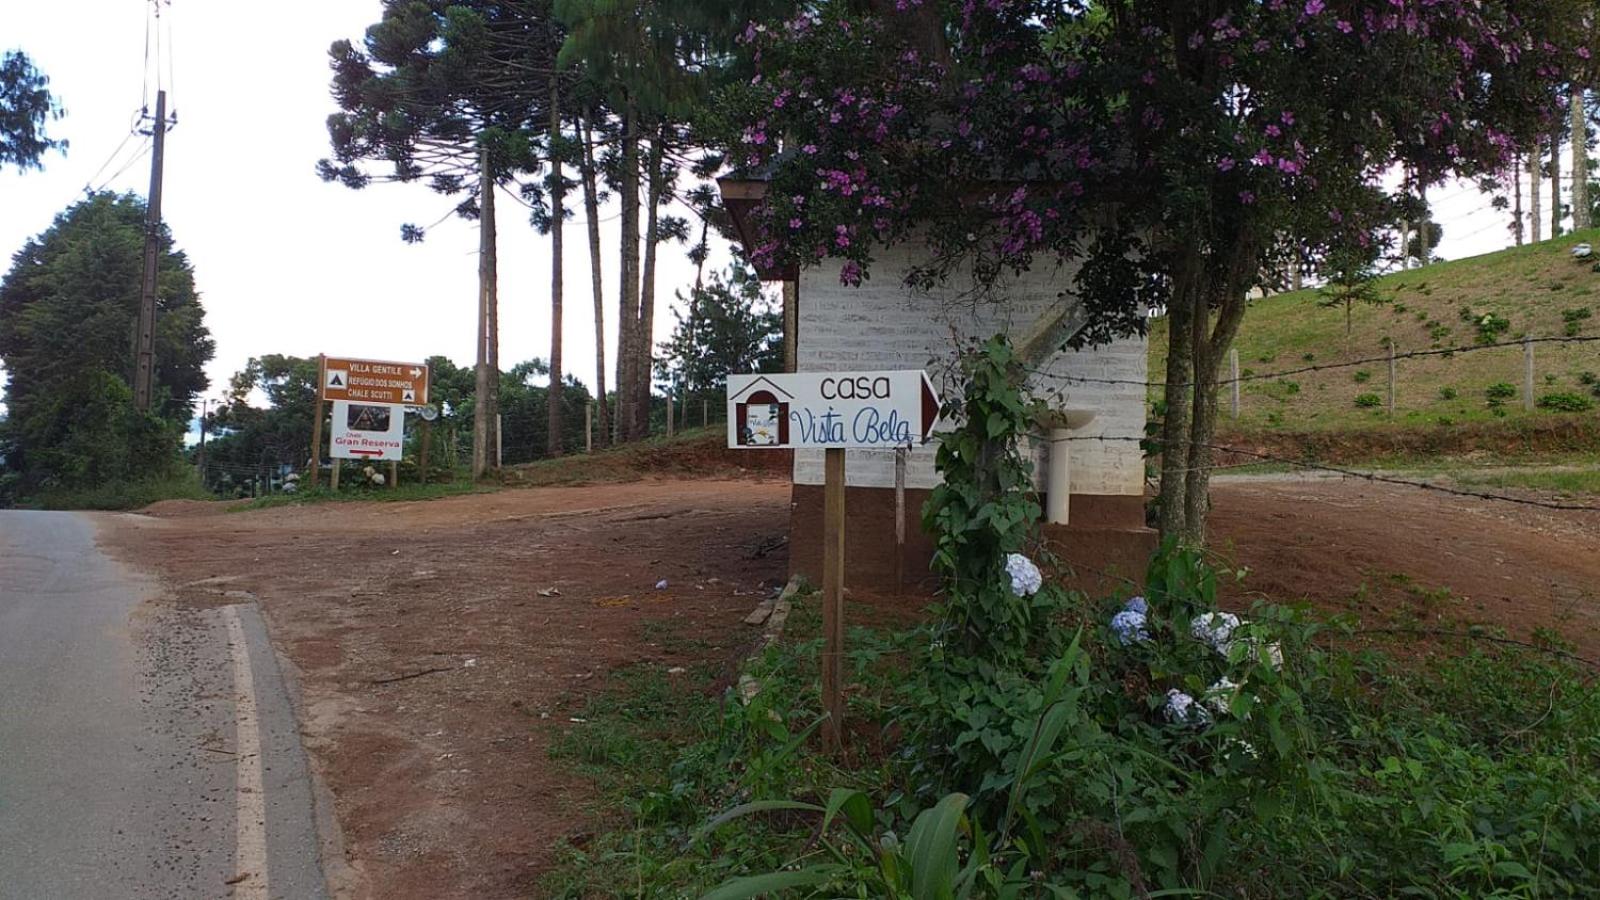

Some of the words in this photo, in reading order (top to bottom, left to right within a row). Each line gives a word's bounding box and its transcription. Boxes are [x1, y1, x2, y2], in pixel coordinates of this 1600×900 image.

[349, 363, 370, 373] VILLA
[372, 365, 402, 375] GENTILE
[375, 378, 388, 387] DOS
[388, 379, 413, 389] SONHOS
[820, 376, 890, 400] casa
[790, 406, 847, 443] Vista
[853, 406, 914, 443] Bela
[335, 437, 359, 446] Gran
[362, 438, 400, 448] Reserva
